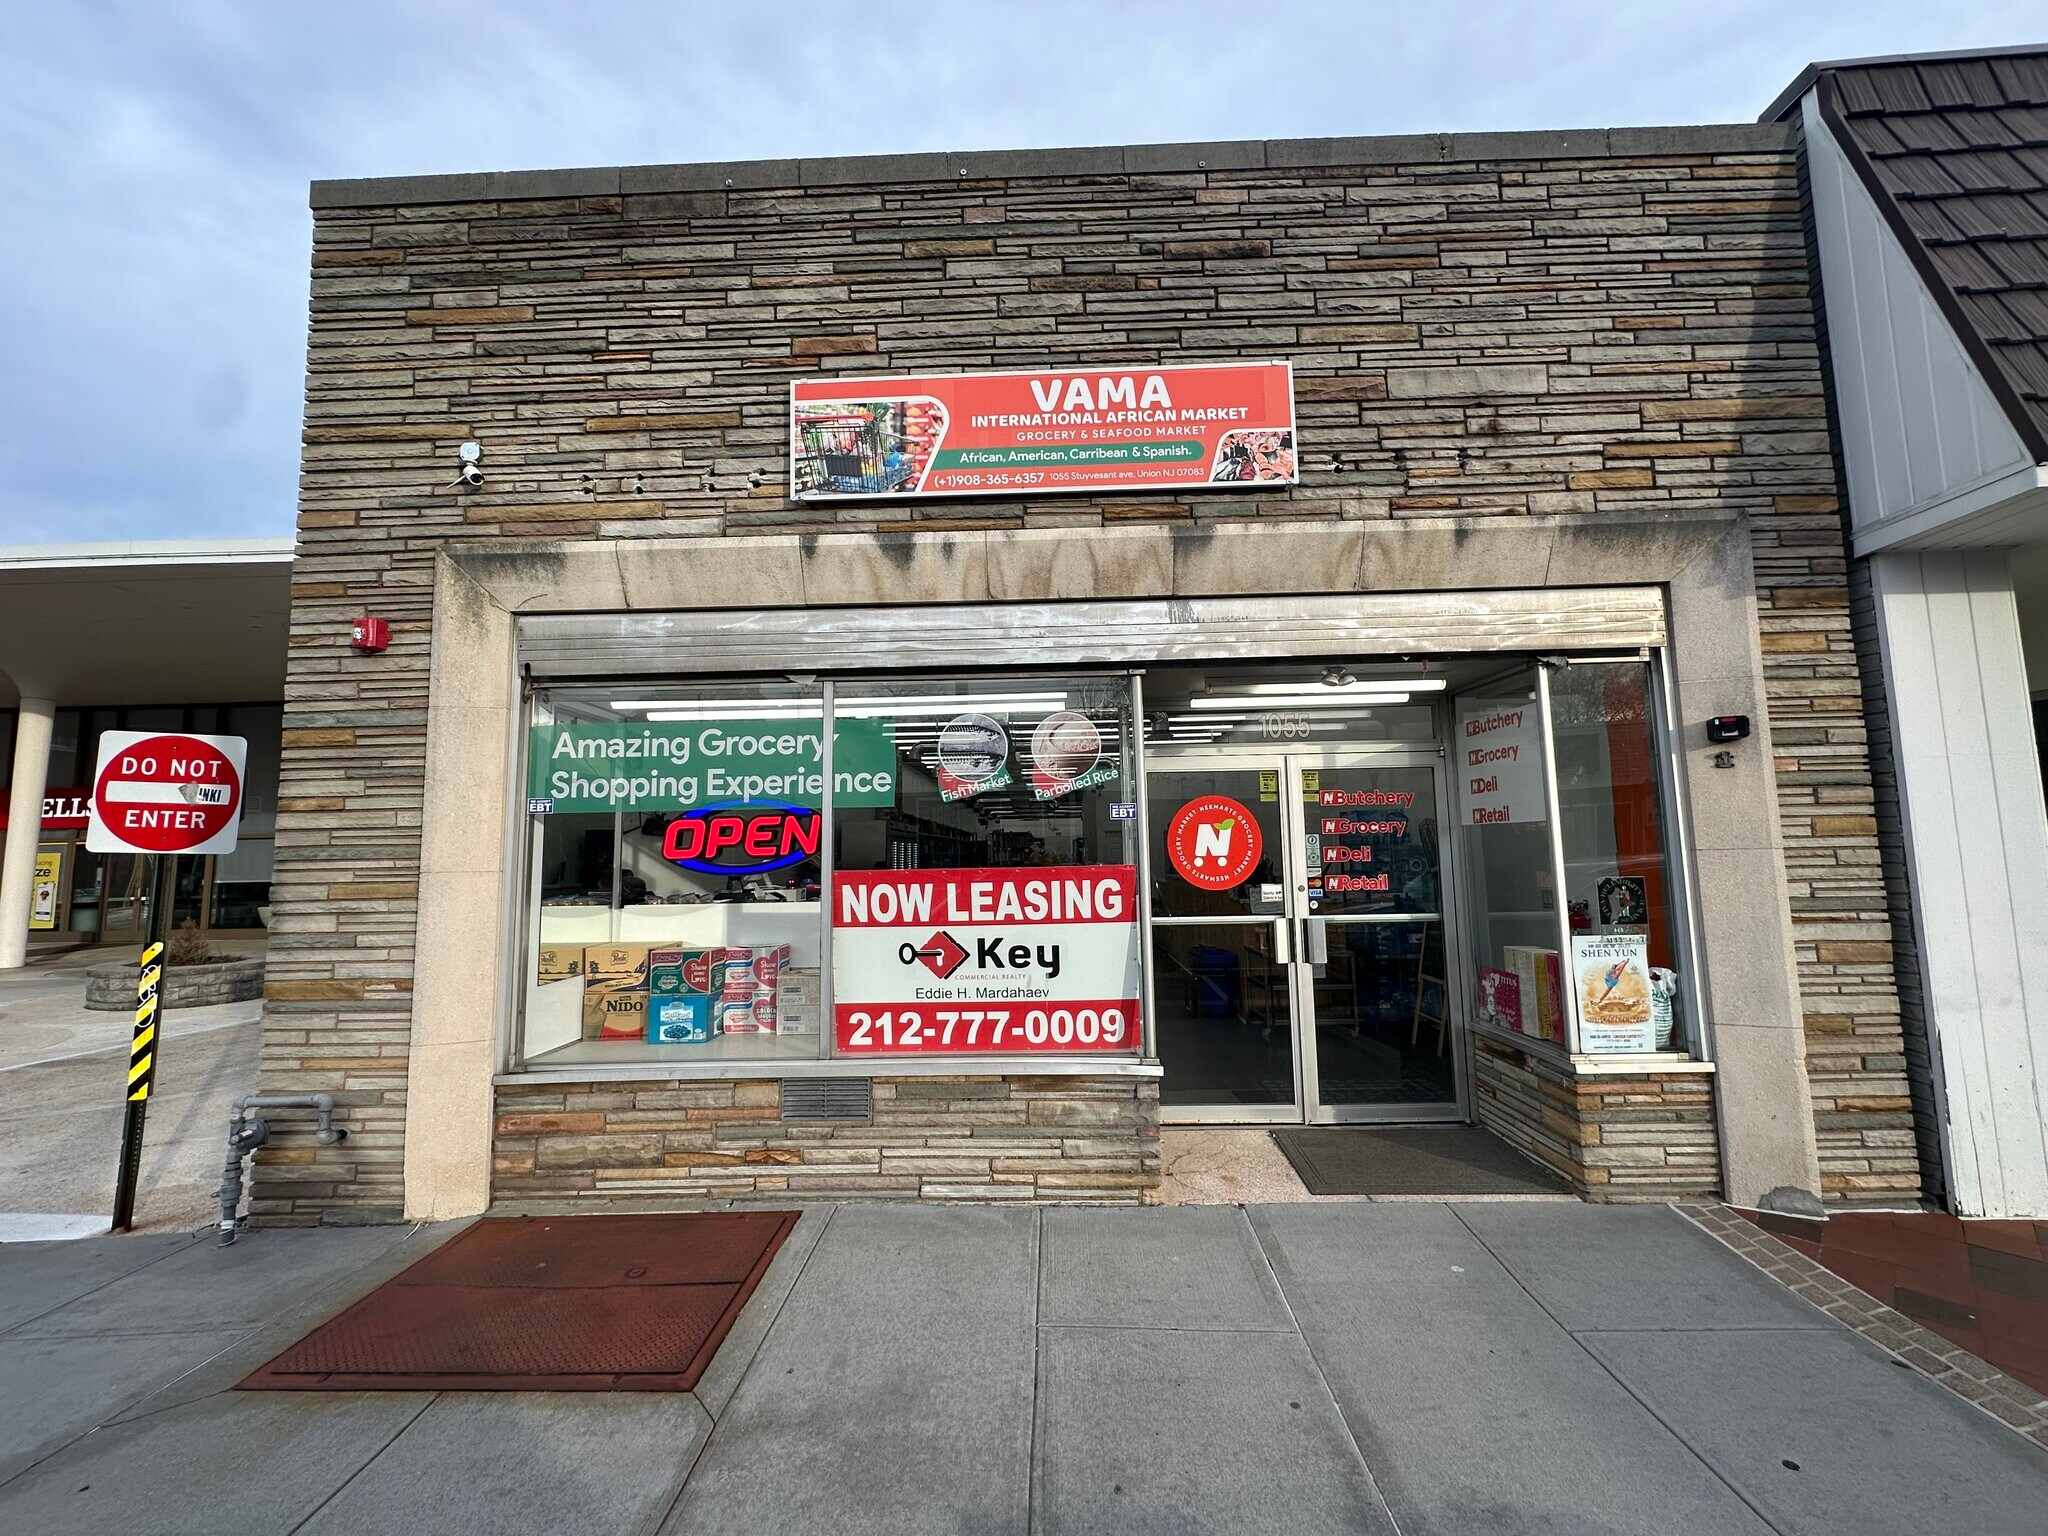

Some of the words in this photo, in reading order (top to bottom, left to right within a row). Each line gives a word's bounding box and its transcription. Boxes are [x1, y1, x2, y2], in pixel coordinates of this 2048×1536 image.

[1030, 375, 1173, 412] VAMA
[971, 411, 1103, 428] INTERNATIONAL
[1105, 408, 1178, 424] AFRICAN
[1180, 407, 1249, 421] MARKET
[1016, 430, 1076, 442] GROCERY
[1080, 430, 1089, 440] &
[1092, 427, 1153, 439] SEAFOOD
[1155, 425, 1207, 437] MARKET
[959, 451, 1007, 465] African,
[1008, 448, 1069, 463] American,
[1069, 445, 1129, 460] Carribean
[1132, 446, 1142, 458] &
[1142, 444, 1193, 460] Spanish.
[933, 471, 1046, 488] (+1)908-365-6357
[1049, 472, 1071, 482] 1055
[1070, 469, 1118, 484] Stuyvesant
[1118, 470, 1137, 482] ave,
[1136, 468, 1162, 480] Union
[1163, 467, 1176, 478] NJ
[1177, 466, 1206, 478] 07083
[1258, 712, 1312, 739] 1055
[1474, 711, 1523, 734] Butchery
[552, 731, 690, 765] Amazing
[698, 727, 840, 763] Grocery
[1477, 745, 1519, 764] Grocery
[121, 756, 157, 775] DO
[169, 759, 222, 777] NOT
[550, 769, 699, 805] Shopping
[707, 767, 892, 803] Experience
[940, 786, 970, 802] Fish
[968, 774, 1012, 797] Market
[1033, 779, 1092, 800] Parboiled
[1094, 768, 1120, 787] Rice
[1478, 776, 1498, 793] Deli
[530, 803, 552, 812] EBT
[1337, 789, 1415, 808] Butchery
[125, 810, 206, 829] ENTER
[1112, 808, 1135, 818] EBT
[1177, 809, 1197, 835] MARKET
[1480, 805, 1510, 822] Retail
[663, 815, 821, 860] OPEN
[1237, 814, 1254, 848] GROCERY
[1339, 817, 1407, 837] Grocery
[1175, 836, 1192, 870] GROCERY
[1233, 849, 1253, 876] MARKET
[1340, 845, 1372, 862] Deli
[1341, 873, 1389, 891] Retail
[841, 883, 933, 923] NOW
[946, 878, 1123, 922] LEASING
[977, 937, 1060, 979] Key
[1581, 949, 1611, 957] SHEN
[1614, 949, 1637, 957] YUN
[1500, 975, 1517, 987] TITUS
[915, 987, 953, 999] Eddie
[957, 987, 971, 999] H.
[976, 986, 1050, 998] Mardahaev
[606, 1000, 643, 1012] NIDO
[849, 1009, 1125, 1046] 212-777-0009
